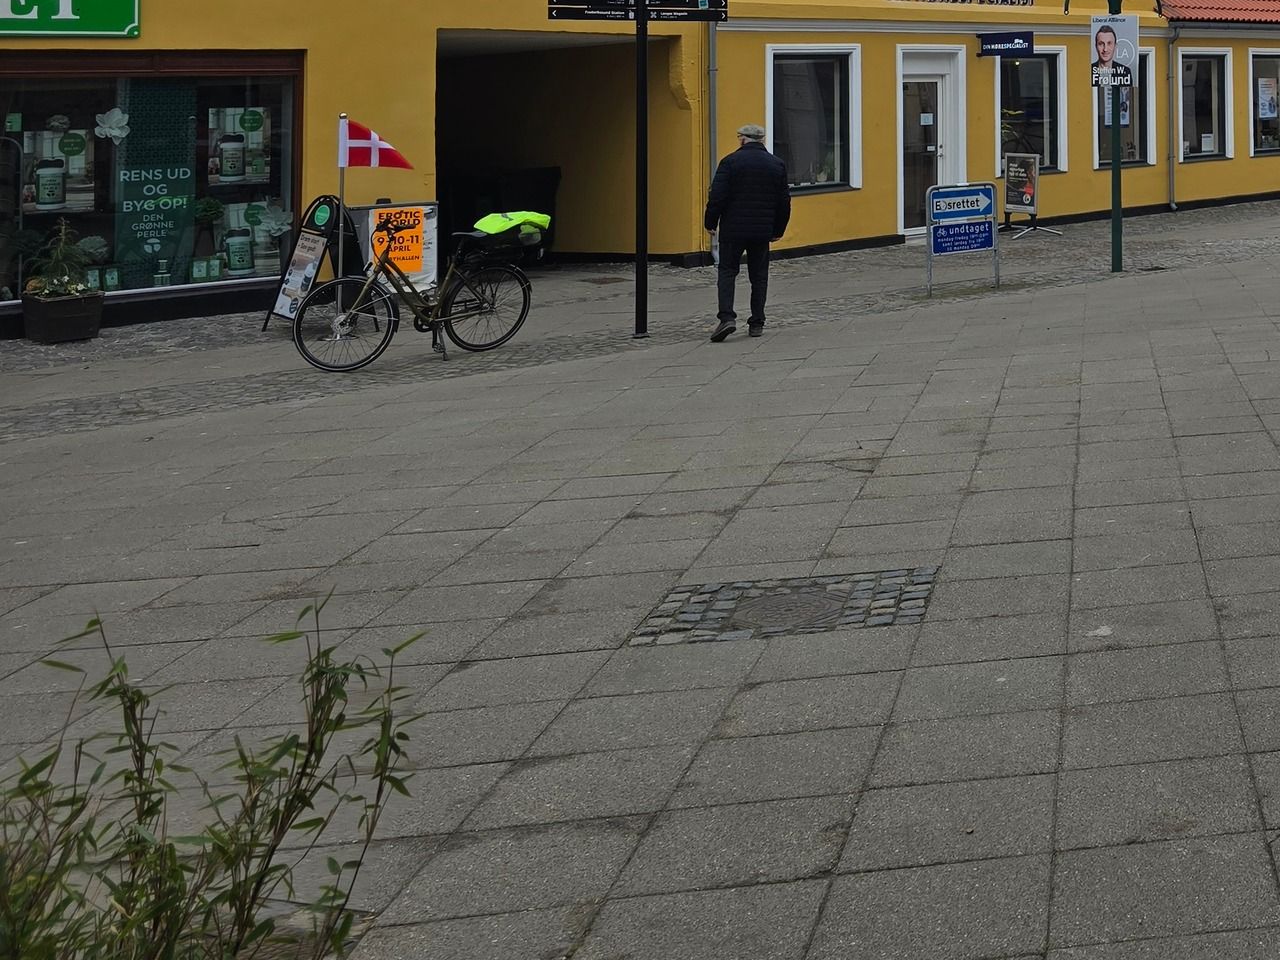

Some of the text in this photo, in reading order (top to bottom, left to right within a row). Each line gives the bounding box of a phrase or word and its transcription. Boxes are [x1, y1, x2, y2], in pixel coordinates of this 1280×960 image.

[1117, 48, 1129, 58] LA
[1092, 74, 1130, 85] Frølund
[120, 168, 191, 182] RENS UD
[143, 184, 167, 195] OG
[123, 198, 187, 212] BYG OP!
[936, 198, 980, 210] Esrettet
[379, 210, 420, 220] EROTIC
[132, 221, 174, 230] GRØNNE
[949, 223, 989, 234] undtaget
[137, 230, 167, 238] PERLE
